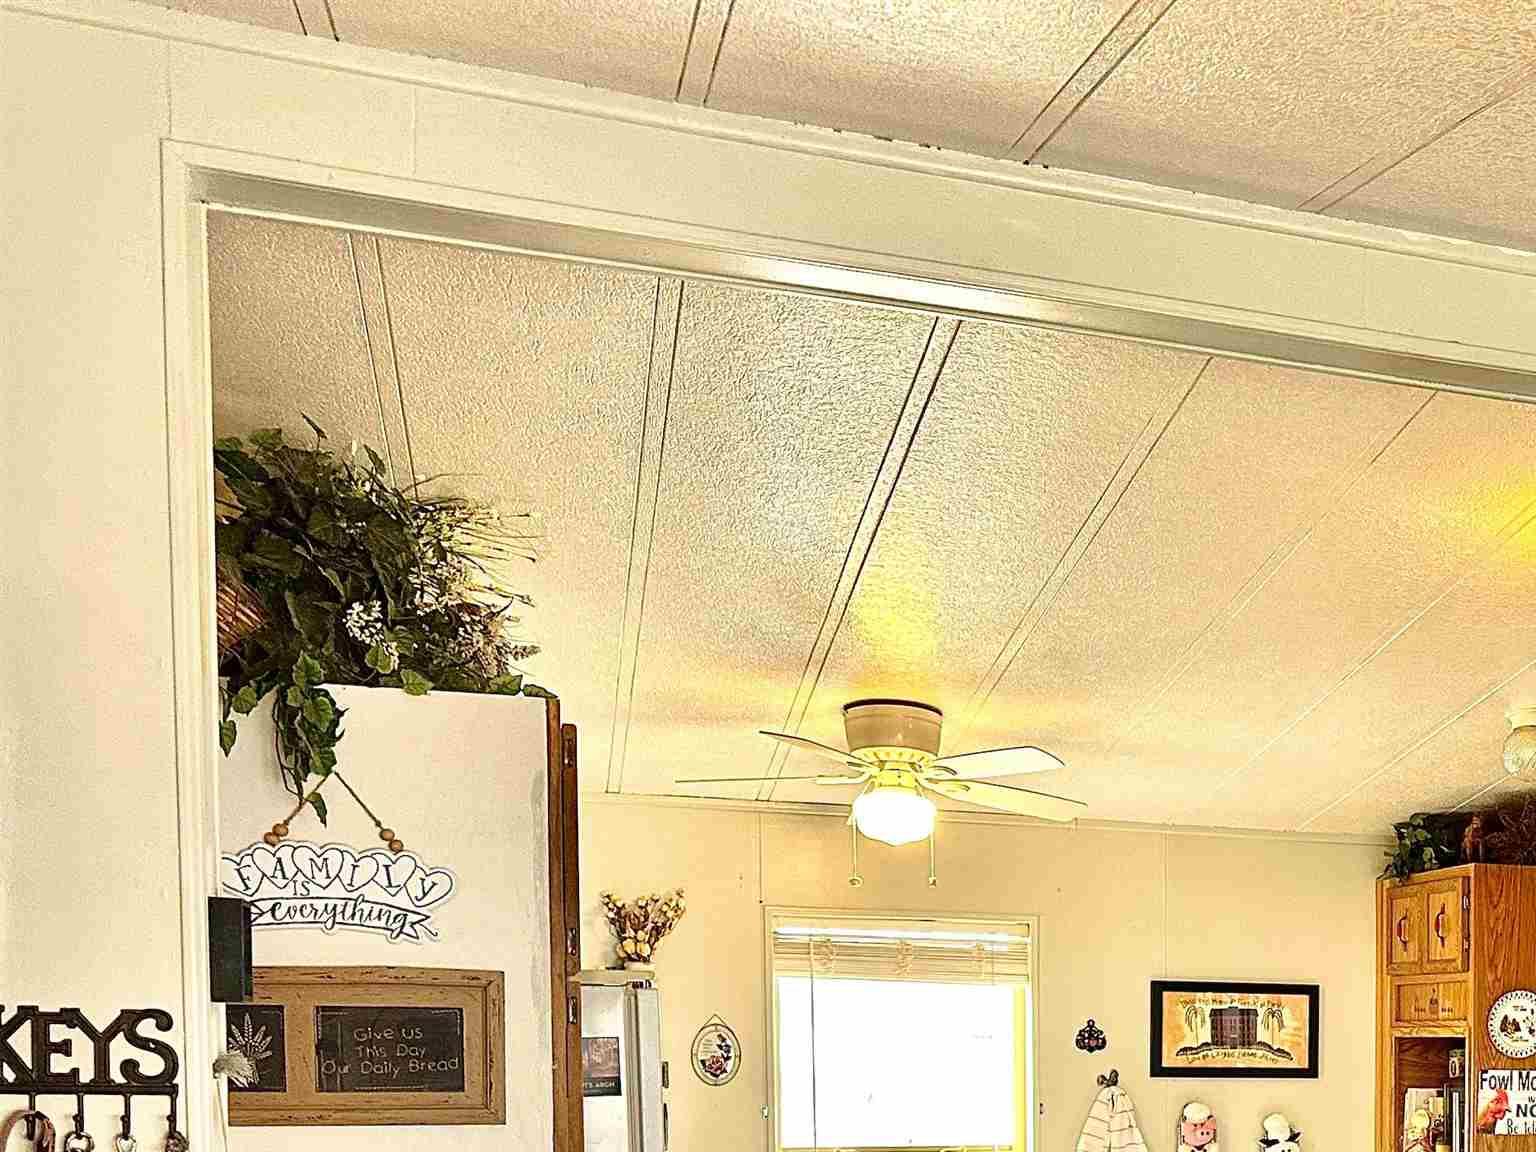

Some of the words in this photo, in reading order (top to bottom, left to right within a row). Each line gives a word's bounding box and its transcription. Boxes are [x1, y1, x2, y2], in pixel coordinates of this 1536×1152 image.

[234, 856, 437, 902] FAMILY
[293, 880, 311, 897] IS
[271, 894, 409, 940] everything
[353, 1026, 394, 1042] Give
[396, 1043, 425, 1058] Day
[321, 1058, 351, 1074] Our
[360, 1060, 400, 1079] Daily
[408, 1057, 459, 1073] Bread
[1480, 1070, 1513, 1091] Fowl
[1507, 1118, 1519, 1135] Be
